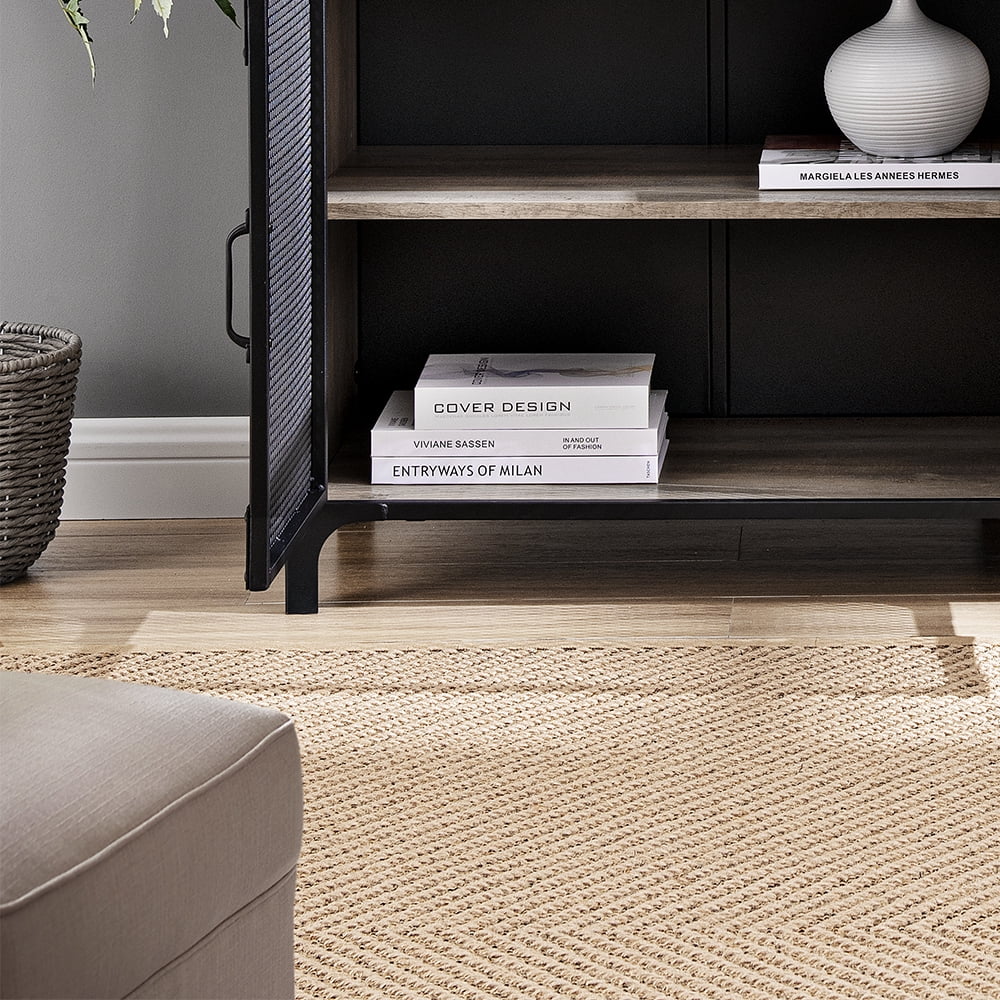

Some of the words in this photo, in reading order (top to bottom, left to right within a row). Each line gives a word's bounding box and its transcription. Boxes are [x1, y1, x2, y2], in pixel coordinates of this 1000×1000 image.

[799, 172, 852, 181] MARGIELA
[854, 172, 873, 181] LES
[874, 171, 916, 181] ANNEES
[917, 171, 960, 180] HERMES
[433, 402, 495, 414] COVER
[502, 401, 571, 413] DESIGN
[413, 440, 453, 449] VIVIANE
[455, 440, 495, 448] SASSEN
[392, 465, 474, 477] ENTRYWAYS
[477, 465, 496, 477] OF
[499, 465, 543, 477] MILAN
